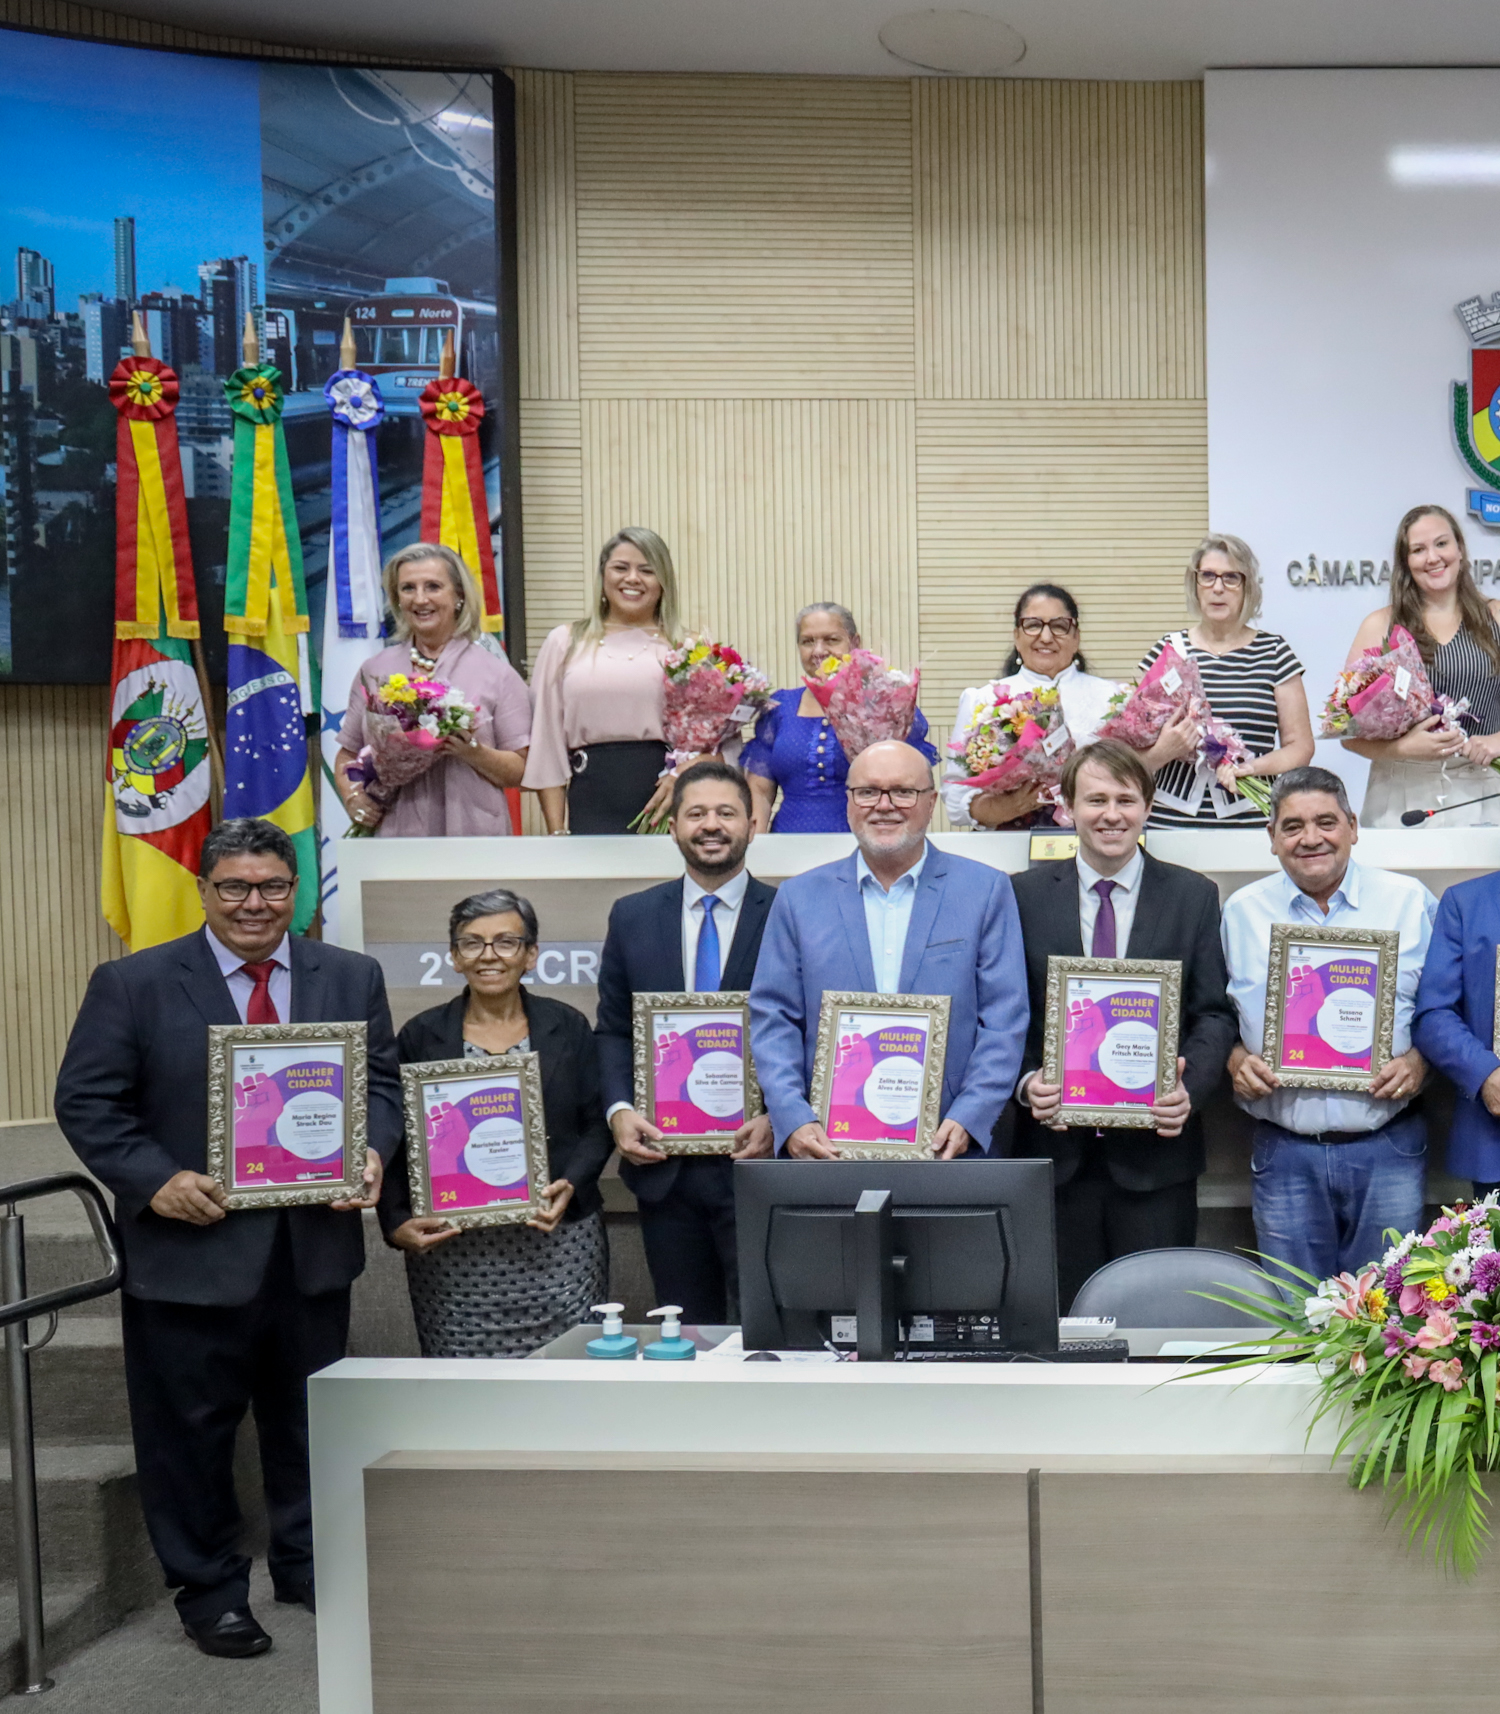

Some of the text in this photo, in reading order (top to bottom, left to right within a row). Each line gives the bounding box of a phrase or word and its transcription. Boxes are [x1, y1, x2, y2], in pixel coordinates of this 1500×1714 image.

[355, 307, 452, 319] 124 Norte
[1287, 553, 1391, 587] CÂMARA
[1329, 964, 1371, 975] MULHER
[1330, 974, 1369, 985] CIDADÃ
[1110, 997, 1154, 1007] MULHER
[1111, 1007, 1152, 1018] CIDADÃ
[695, 1029, 738, 1038] MULHER
[879, 1032, 922, 1042] MULHER
[697, 1037, 737, 1049] CIDADÃ
[879, 1042, 919, 1053] CIDADÃ
[1289, 1049, 1304, 1060] 24
[286, 1067, 334, 1078] MULHER
[288, 1076, 333, 1089] CIDADÃ
[720, 1079, 743, 1087] Camarg
[1069, 1086, 1086, 1097] 24
[469, 1093, 515, 1106] MULHER
[472, 1102, 515, 1117] CIDADÃ
[662, 1117, 678, 1127] 24
[834, 1121, 850, 1132] 24
[246, 1162, 264, 1174] 24
[440, 1191, 457, 1202] 24
